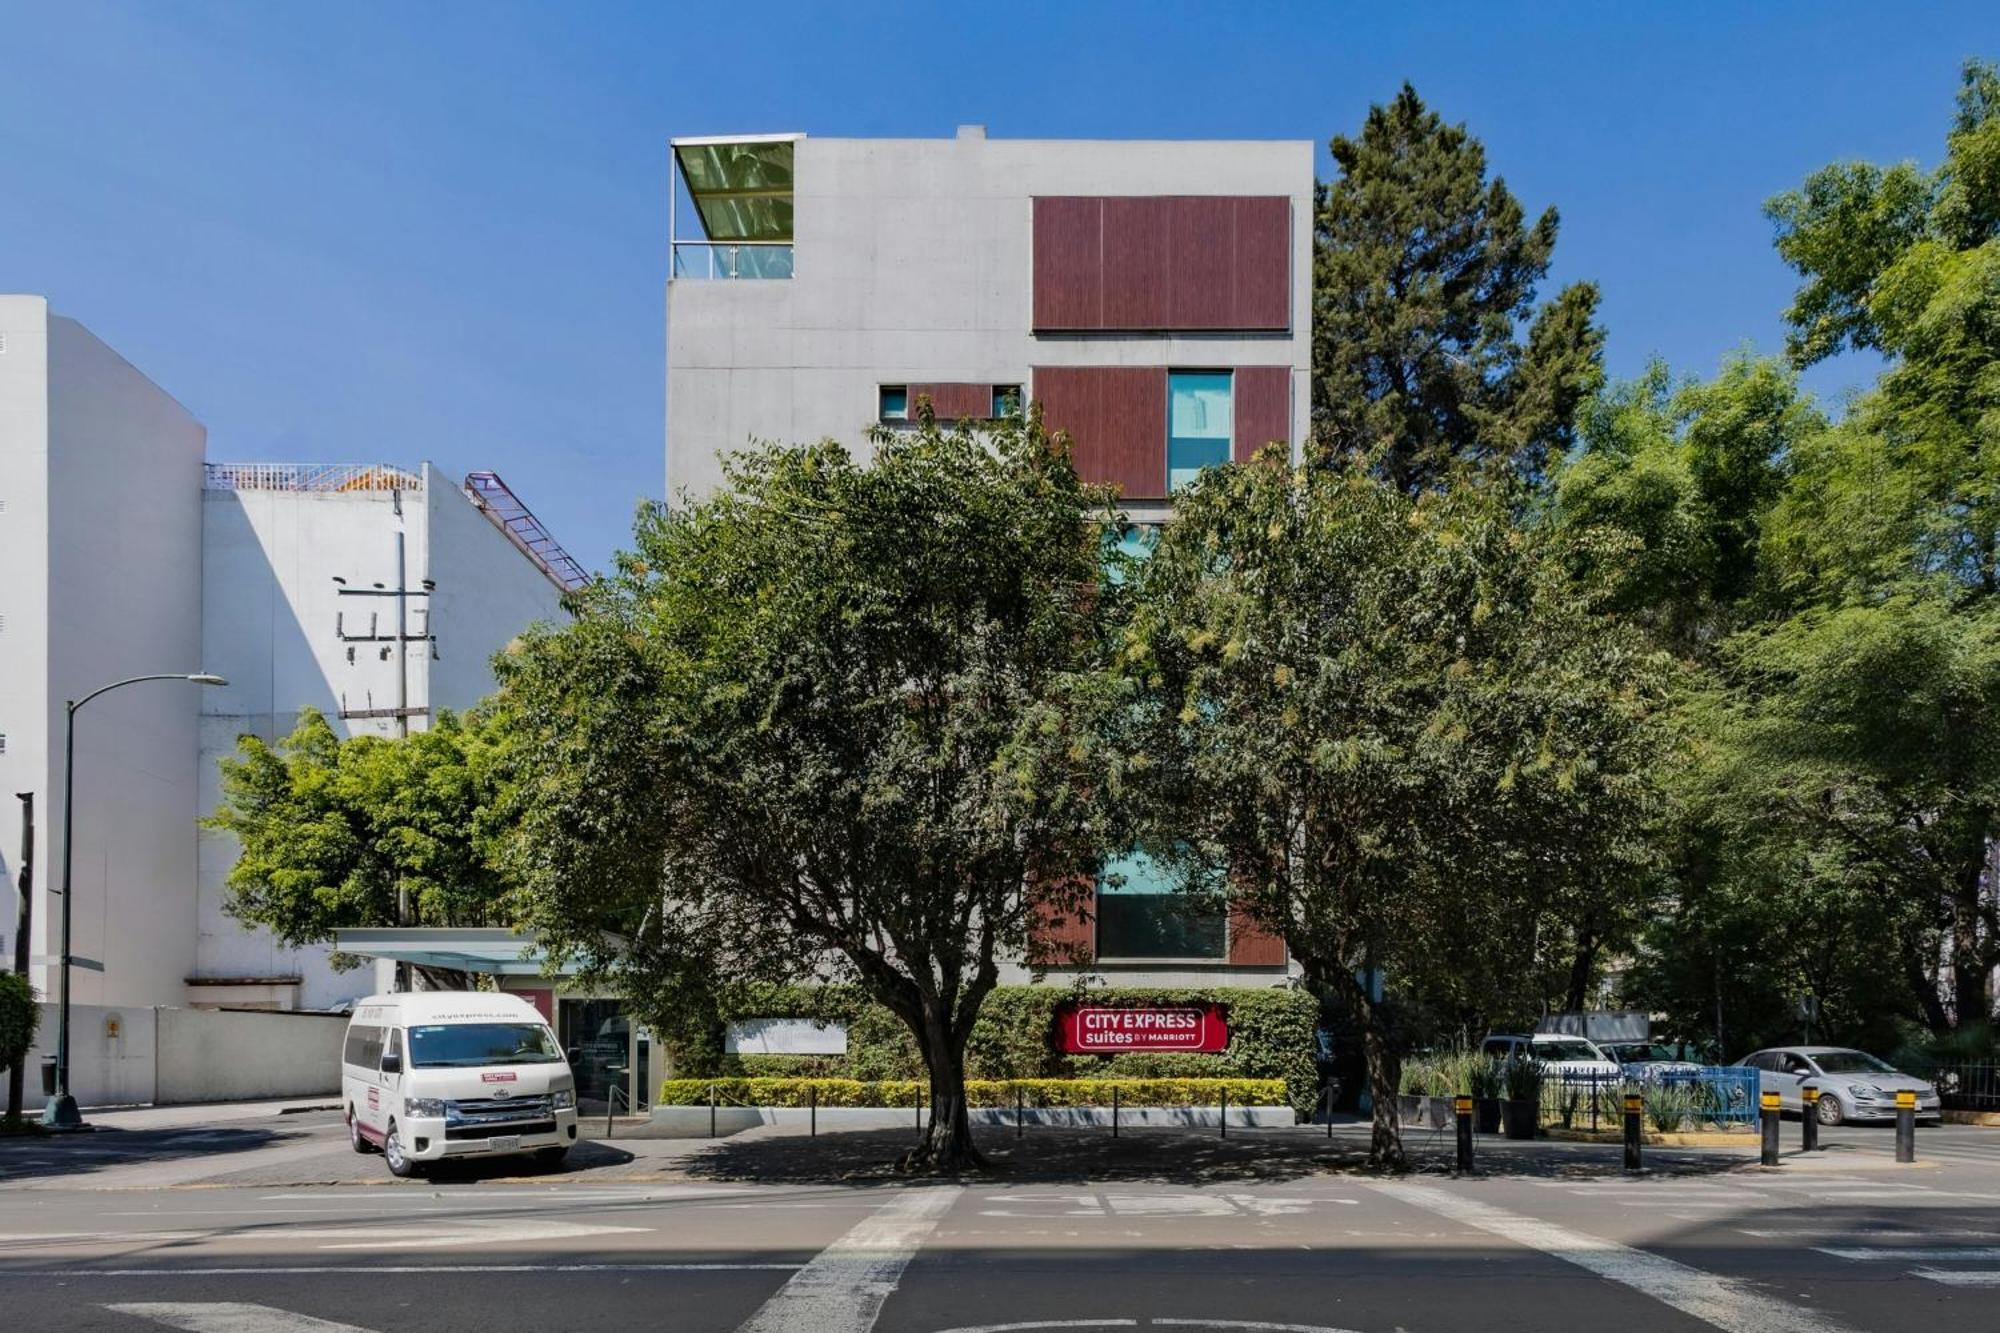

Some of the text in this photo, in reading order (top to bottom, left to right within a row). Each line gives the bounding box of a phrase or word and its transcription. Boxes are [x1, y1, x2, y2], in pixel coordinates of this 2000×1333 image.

[1085, 1014, 1196, 1028] CITY EXPRESS
[1086, 1030, 1133, 1043] suites
